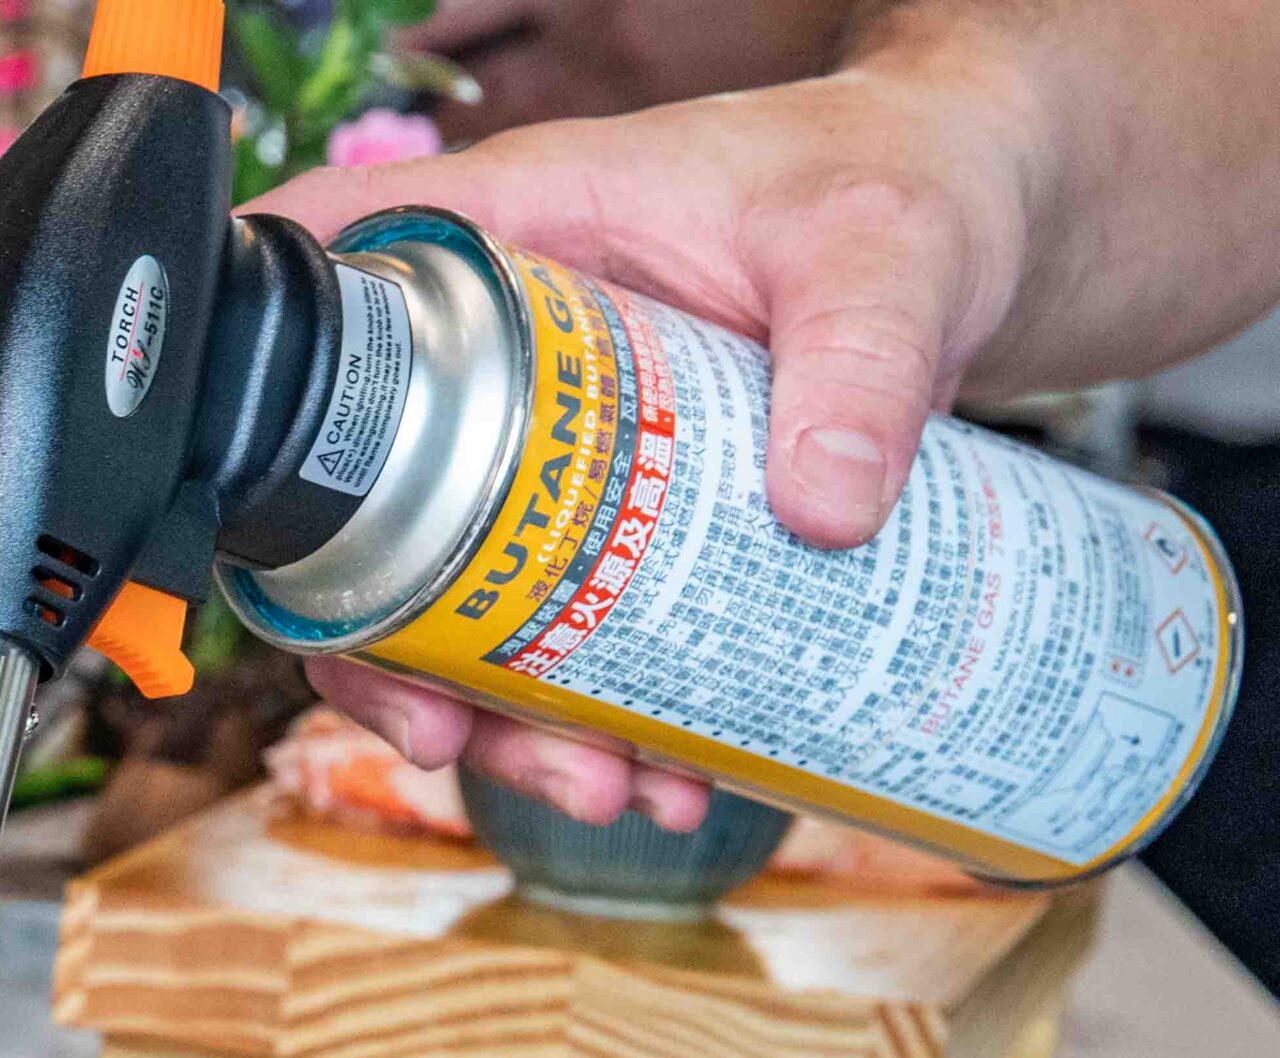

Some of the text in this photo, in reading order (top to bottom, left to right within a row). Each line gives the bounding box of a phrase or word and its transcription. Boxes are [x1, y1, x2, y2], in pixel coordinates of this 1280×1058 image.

[112, 287, 138, 362] TORCH
[366, 312, 374, 334] knob
[366, 336, 374, 351] the
[326, 353, 362, 445] CAUTION
[344, 459, 362, 483] When
[381, 362, 392, 382] may
[344, 414, 360, 441] When
[353, 406, 373, 448] direction
[375, 342, 383, 357] the
[354, 468, 368, 488] until
[378, 386, 398, 440] completely
[391, 360, 400, 384] goes
[455, 351, 582, 620] BUTANE
[533, 407, 597, 564] (LIQUEFIED
[503, 426, 672, 676] 注意火源及高溫
[917, 635, 986, 735] BUTANE
[975, 569, 1002, 631] GAS
